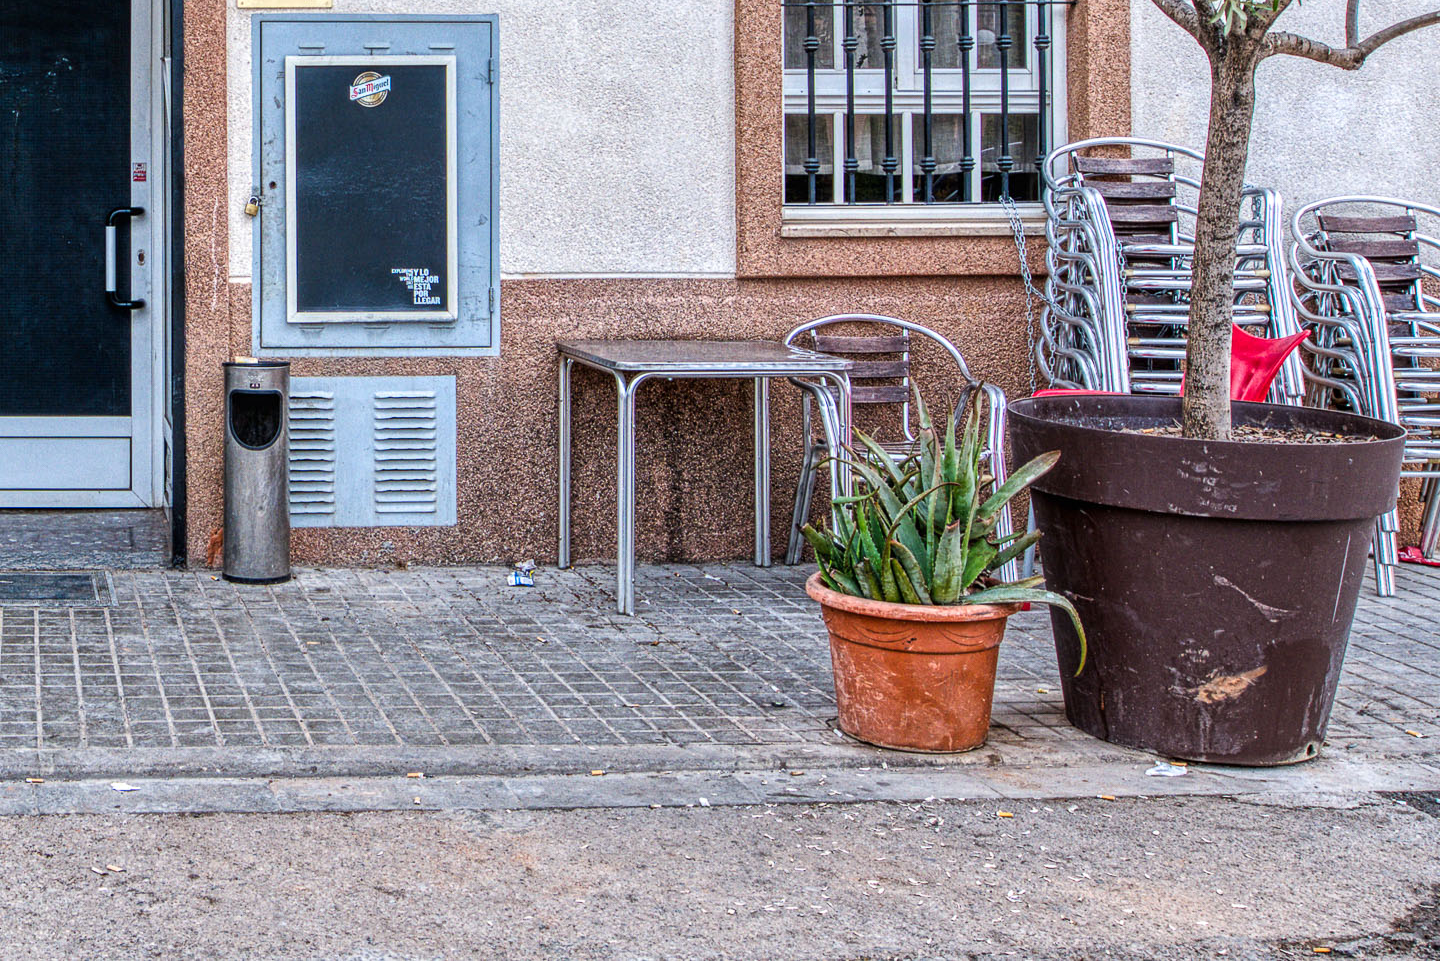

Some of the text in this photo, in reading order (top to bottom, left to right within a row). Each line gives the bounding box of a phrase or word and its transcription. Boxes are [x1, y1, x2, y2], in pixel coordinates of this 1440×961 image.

[419, 268, 430, 276] LO
[414, 275, 440, 284] MEJOR
[414, 296, 441, 305] LLEGAR
